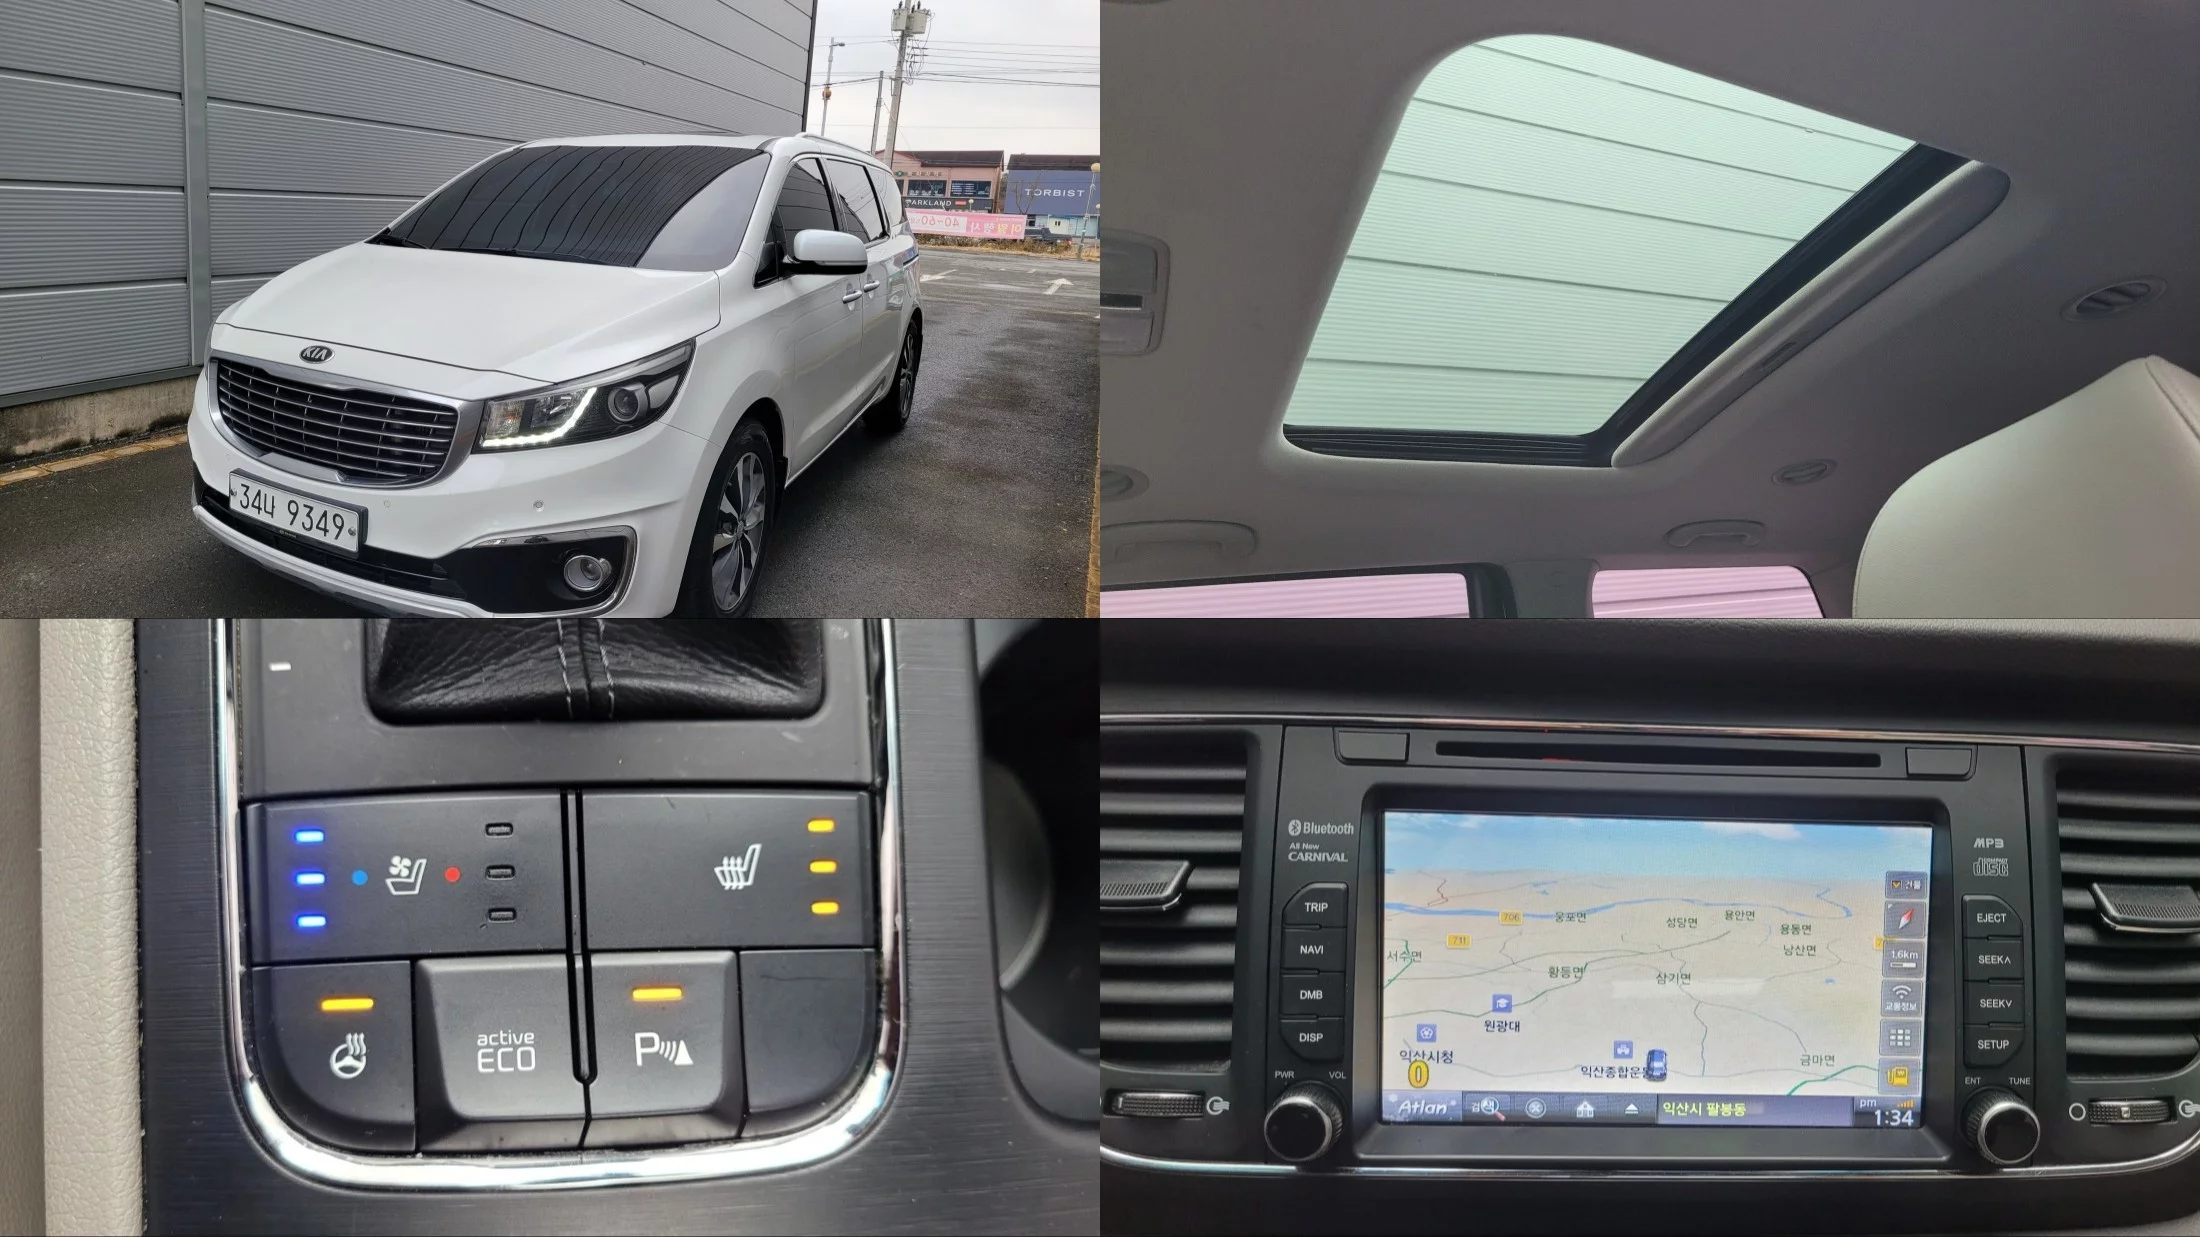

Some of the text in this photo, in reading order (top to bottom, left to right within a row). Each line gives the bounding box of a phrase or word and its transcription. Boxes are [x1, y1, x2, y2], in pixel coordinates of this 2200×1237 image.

[1025, 188, 1085, 197] TORBIST
[302, 347, 328, 360] KIA
[240, 483, 345, 540] 34나 9349
[1303, 822, 1354, 835] Bluetooth
[1290, 842, 1301, 850] All
[1973, 838, 2004, 848] MP3
[1288, 852, 1348, 862] CARNIVAL
[1305, 902, 1328, 912] TRIP
[1555, 912, 1586, 923] 웅포면
[1725, 909, 1755, 921] 용안면
[1976, 913, 2006, 923] EJECT
[1666, 917, 1698, 929] 성당면
[1780, 924, 1812, 935] 용동면
[1300, 945, 1324, 954] NAVI
[1783, 944, 1816, 957] 낭산면
[1891, 950, 1919, 960] 1.6km
[1387, 950, 1422, 963] 서수면
[1548, 966, 1584, 979] 황등면
[1656, 973, 1691, 985] 삼기면
[1300, 990, 1323, 1000] DMB
[1484, 1019, 1521, 1033] 원광대
[477, 1029, 535, 1046] active
[1299, 1033, 1323, 1042] DISP
[1978, 1039, 2009, 1049] SETUP
[477, 1046, 536, 1073] ECO
[1399, 1050, 1454, 1064] 익산시청
[1800, 1054, 1835, 1067] 금마면
[1329, 1071, 1346, 1079] VOL
[1408, 1060, 1429, 1089] 0
[1965, 1077, 1981, 1085] ENT
[2009, 1077, 2031, 1085] TUNE
[1398, 1099, 1448, 1115] Atlan
[1860, 1098, 1877, 1108] pm
[1663, 1102, 1747, 1117] 익산시 팔봉동
[1875, 1109, 1914, 1126] 1:34
